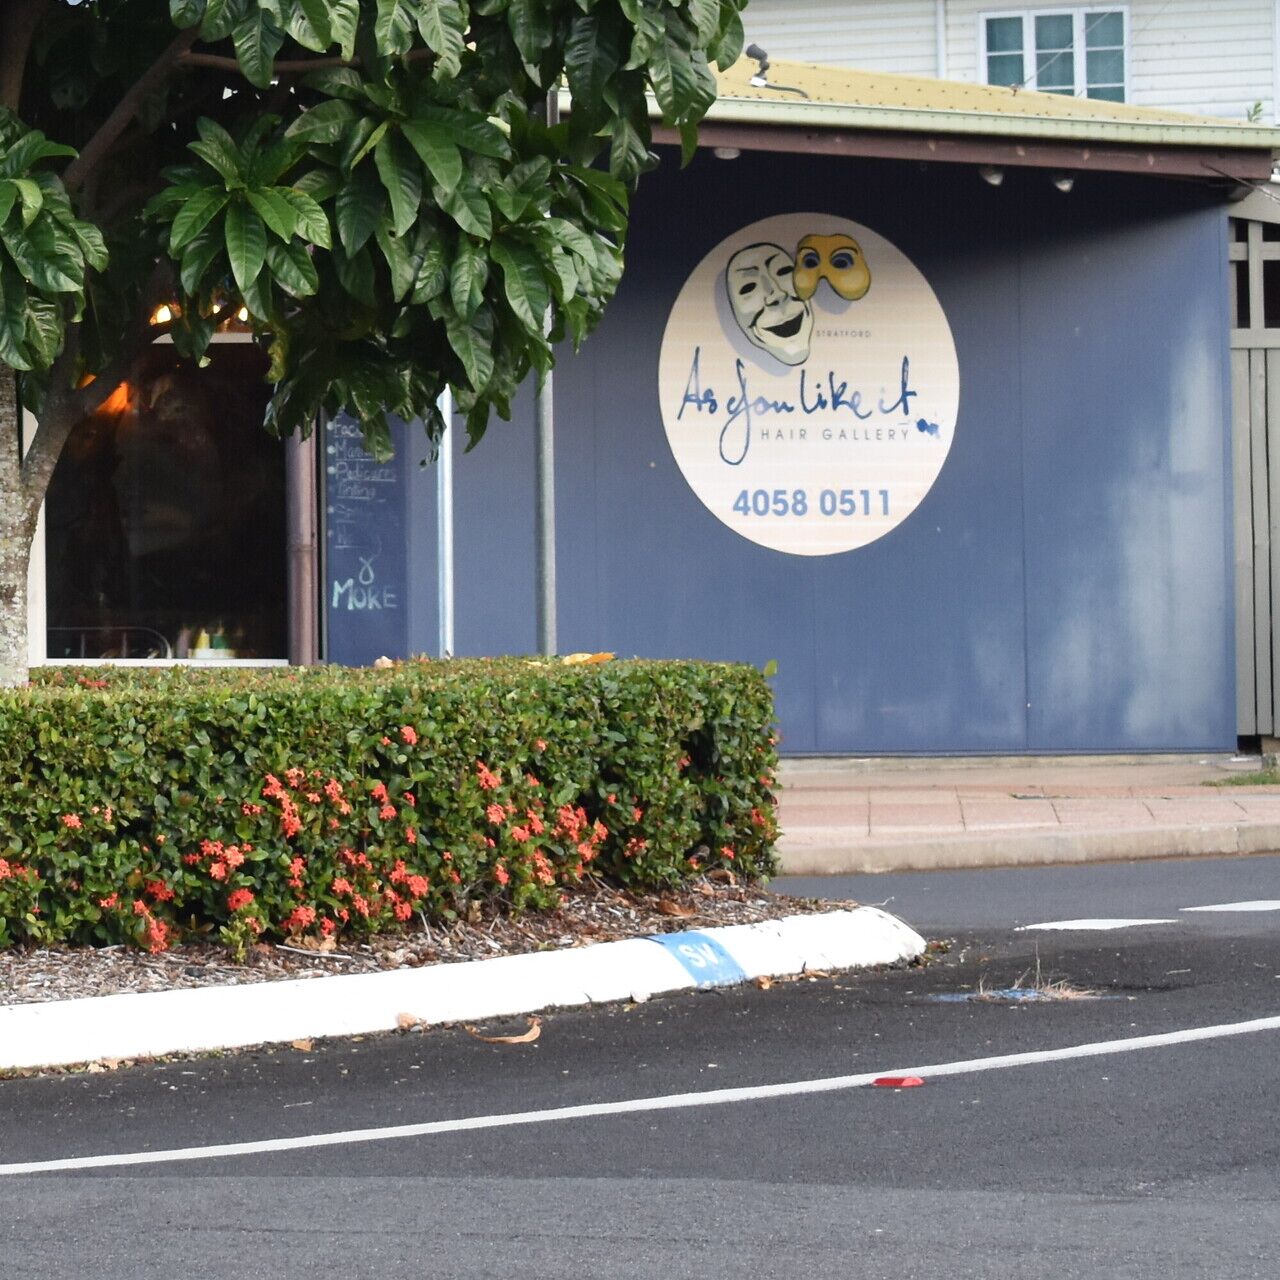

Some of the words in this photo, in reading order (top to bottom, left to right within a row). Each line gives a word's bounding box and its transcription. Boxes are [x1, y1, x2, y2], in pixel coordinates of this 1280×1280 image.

[816, 330, 872, 338] STRATFORD
[677, 346, 718, 420] As
[761, 429, 808, 440] HAIR
[822, 429, 910, 440] GALLERY
[732, 489, 808, 516] 4058
[819, 489, 890, 516] 0511
